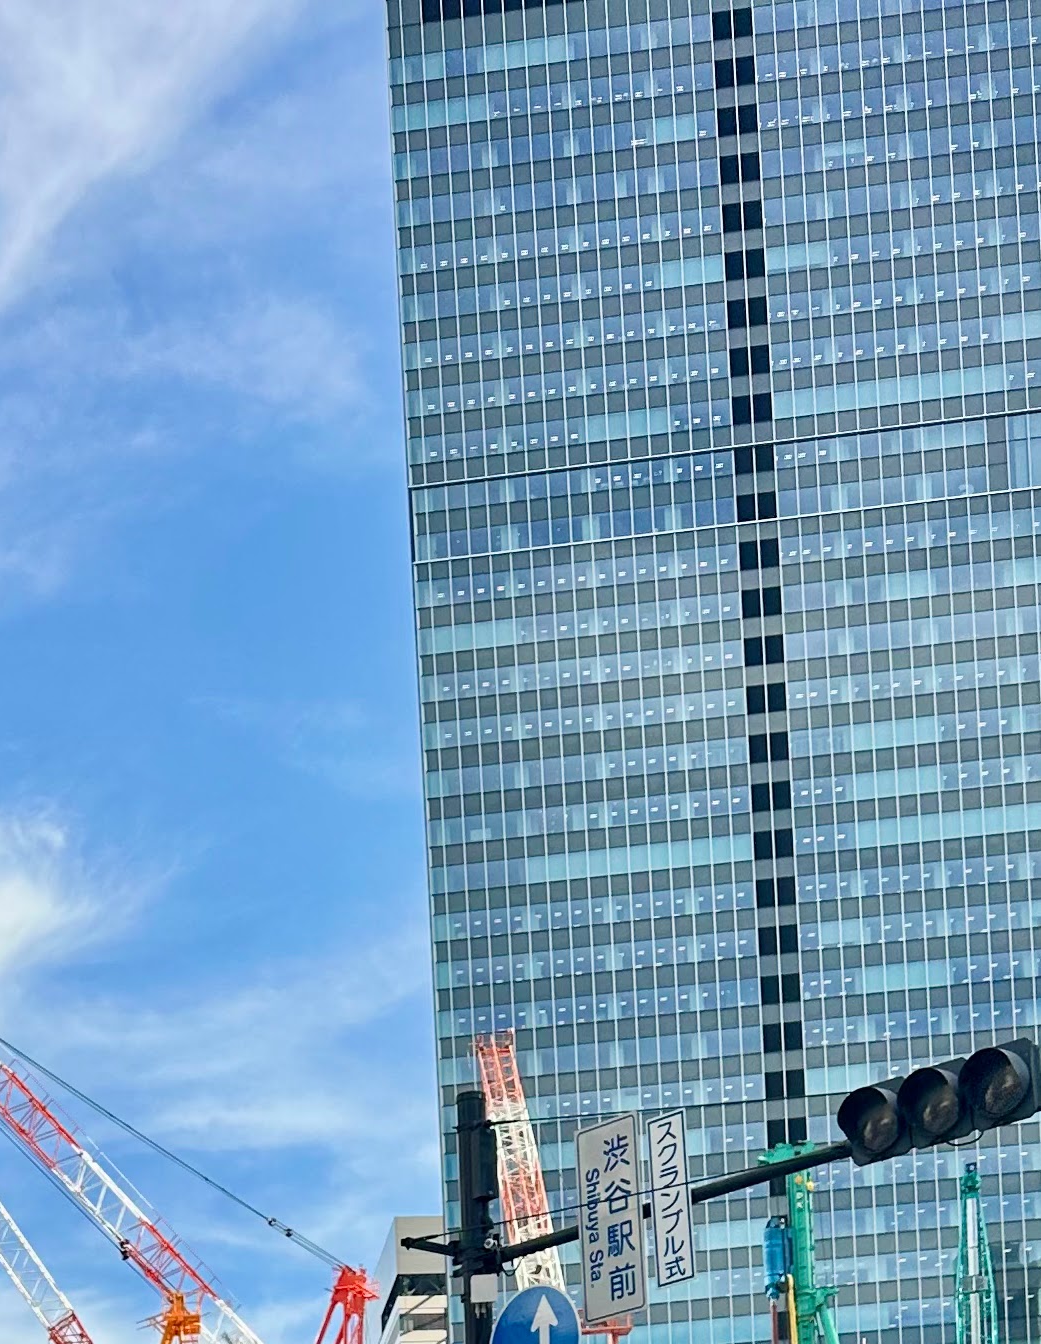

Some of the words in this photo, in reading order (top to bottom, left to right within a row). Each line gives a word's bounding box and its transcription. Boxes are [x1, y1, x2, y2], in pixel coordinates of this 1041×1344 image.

[585, 1168, 601, 1245] Shibuya
[603, 1134, 636, 1301] 渋谷駅前
[657, 1121, 687, 1280] スクランブル式
[589, 1250, 604, 1289] Sta.
